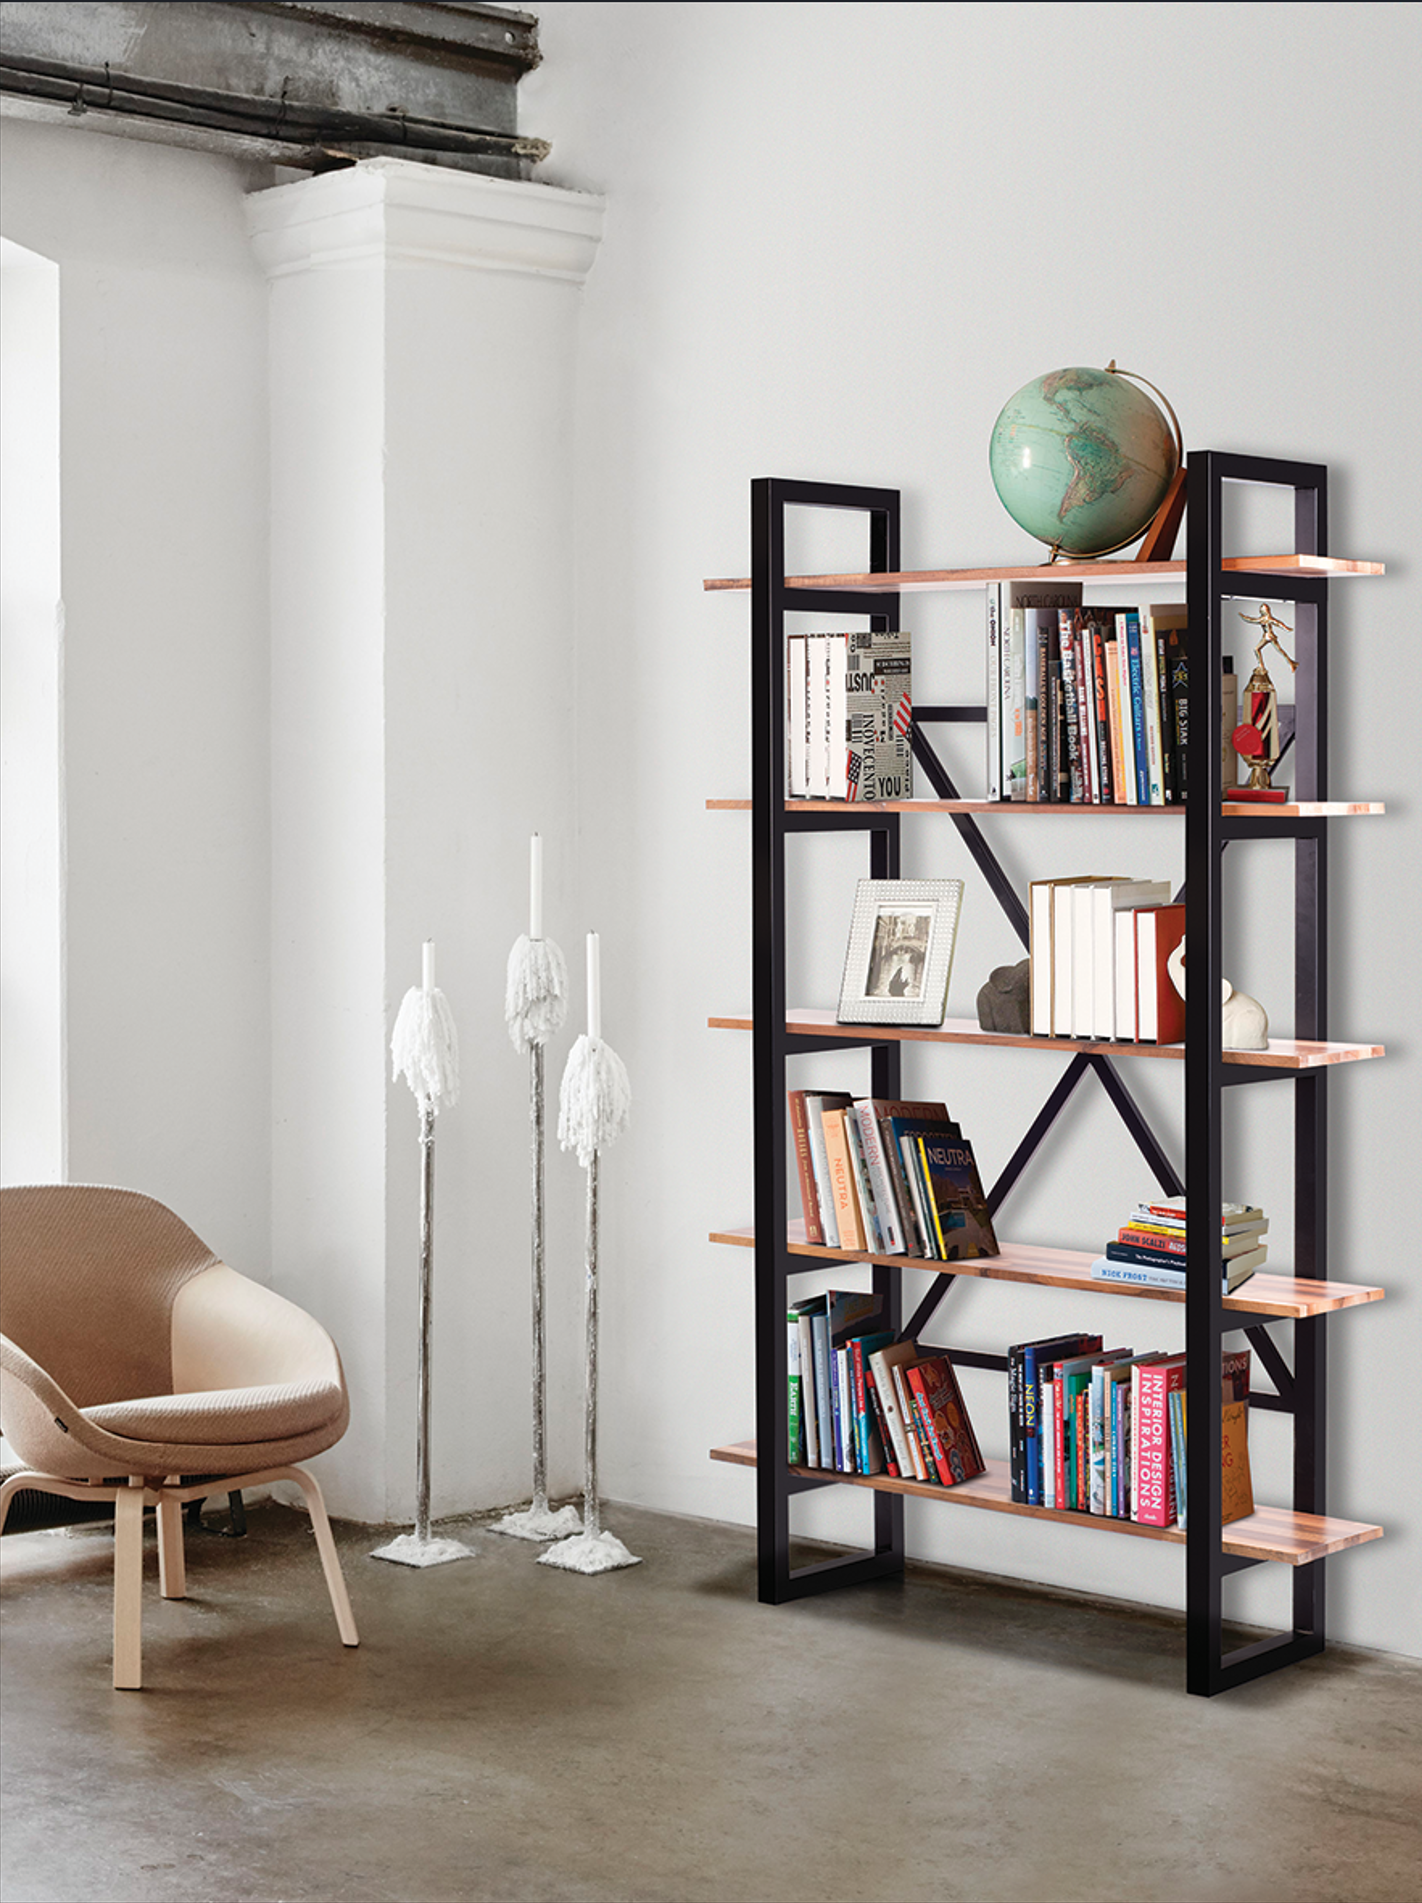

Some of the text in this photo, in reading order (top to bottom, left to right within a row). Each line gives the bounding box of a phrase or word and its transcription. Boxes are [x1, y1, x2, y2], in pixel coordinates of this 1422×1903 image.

[989, 619, 997, 647] ONION
[1060, 619, 1079, 760] The Basketball Book
[1130, 659, 1139, 695] Electric
[1133, 696, 1142, 731] Guitars
[1179, 699, 1188, 717] BIG
[878, 776, 901, 797] YOU
[859, 1105, 879, 1167] MODERN
[927, 1147, 975, 1166] NEUTRA
[834, 1158, 848, 1210] NEUTRA
[1122, 1232, 1140, 1244] JOHN
[1141, 1236, 1166, 1249] SCALZI
[1122, 1270, 1148, 1282] FROST
[789, 1382, 799, 1416] EARTH
[1025, 1384, 1035, 1426] NEON
[1139, 1373, 1152, 1508] INSPIRATIONS
[1151, 1374, 1164, 1510] INTERIOR DESIGN
